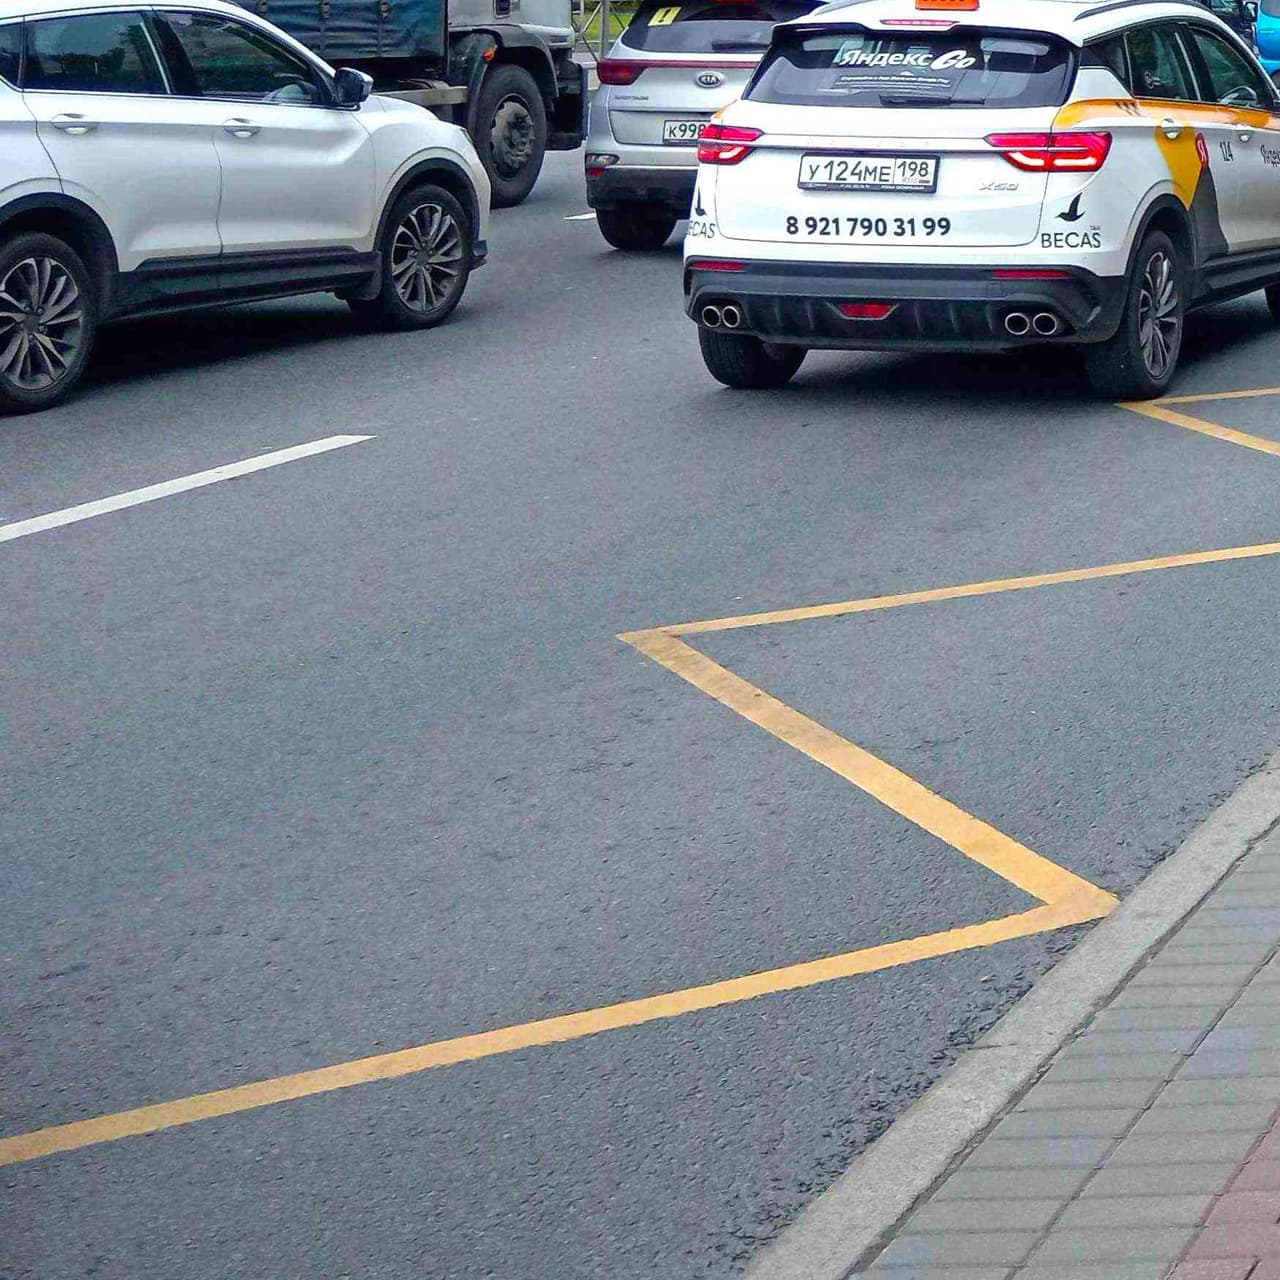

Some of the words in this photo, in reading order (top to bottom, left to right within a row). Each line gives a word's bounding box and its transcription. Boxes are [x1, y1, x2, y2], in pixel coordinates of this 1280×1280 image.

[839, 49, 933, 67] Яндекс
[930, 49, 976, 70] Go
[701, 75, 718, 84] KIA
[897, 161, 929, 178] 198
[786, 216, 799, 235] 8
[805, 217, 840, 236] 921
[847, 218, 887, 237] 790
[893, 218, 916, 236] 31
[922, 217, 951, 236] 99
[1041, 232, 1101, 248] BECAS
